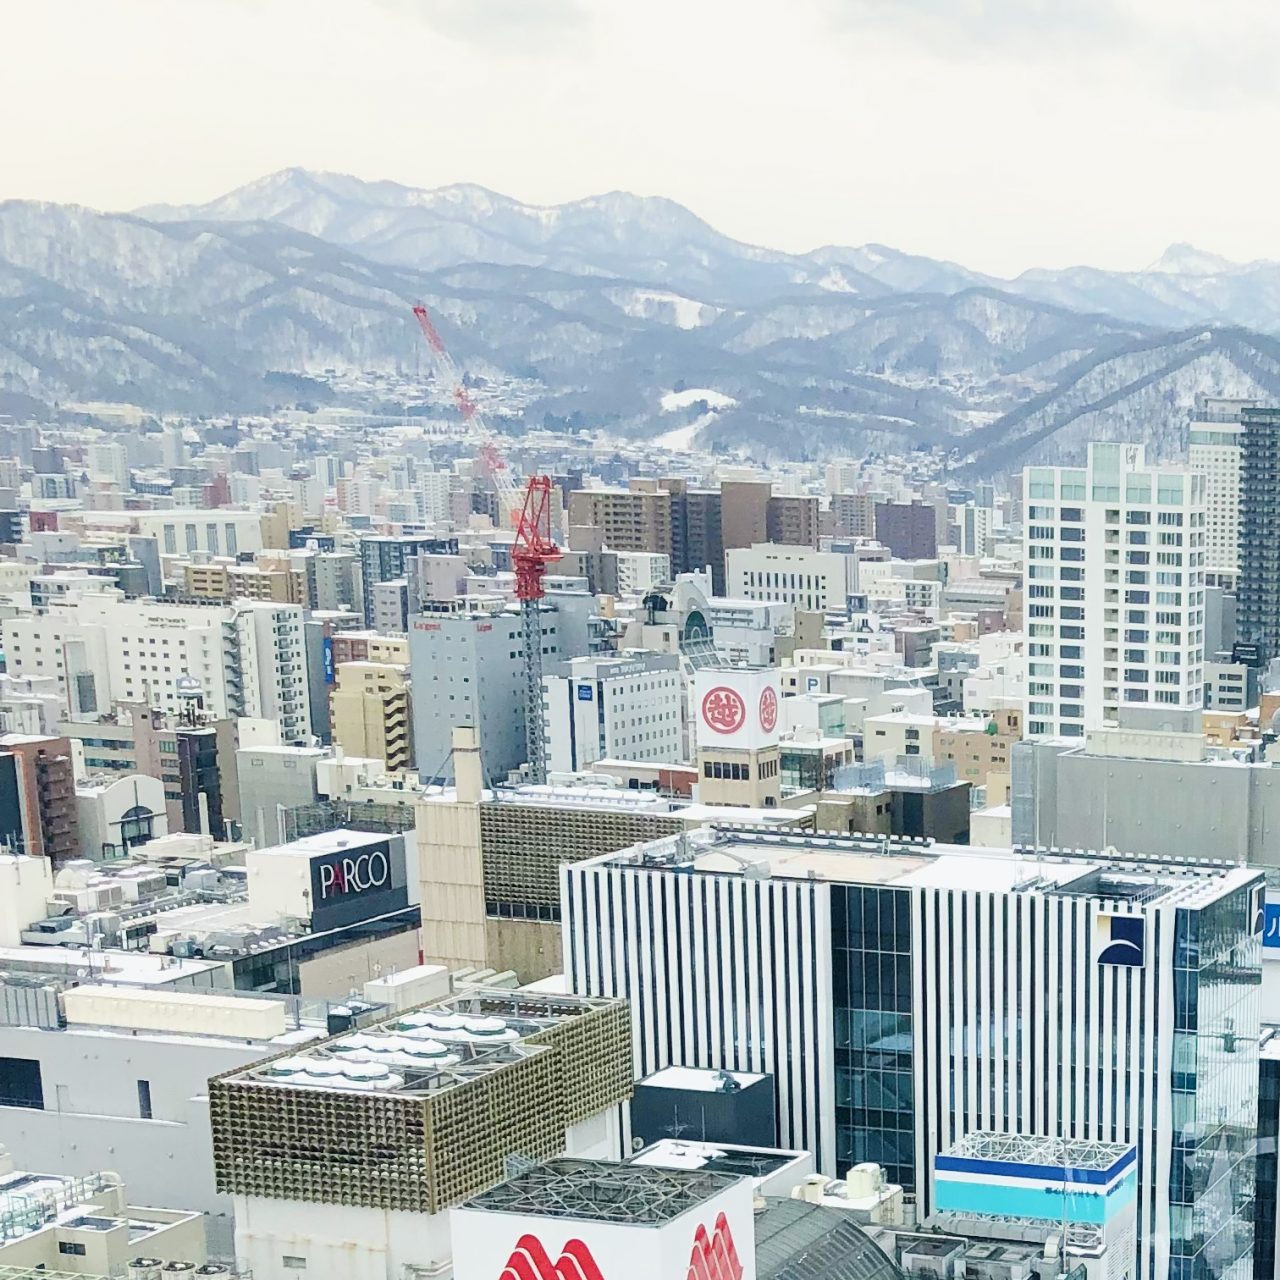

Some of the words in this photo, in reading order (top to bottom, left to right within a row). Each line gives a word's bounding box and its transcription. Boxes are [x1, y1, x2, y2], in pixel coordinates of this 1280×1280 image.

[808, 679, 818, 691] P
[706, 691, 741, 729] 越
[319, 851, 388, 899] PARCO
